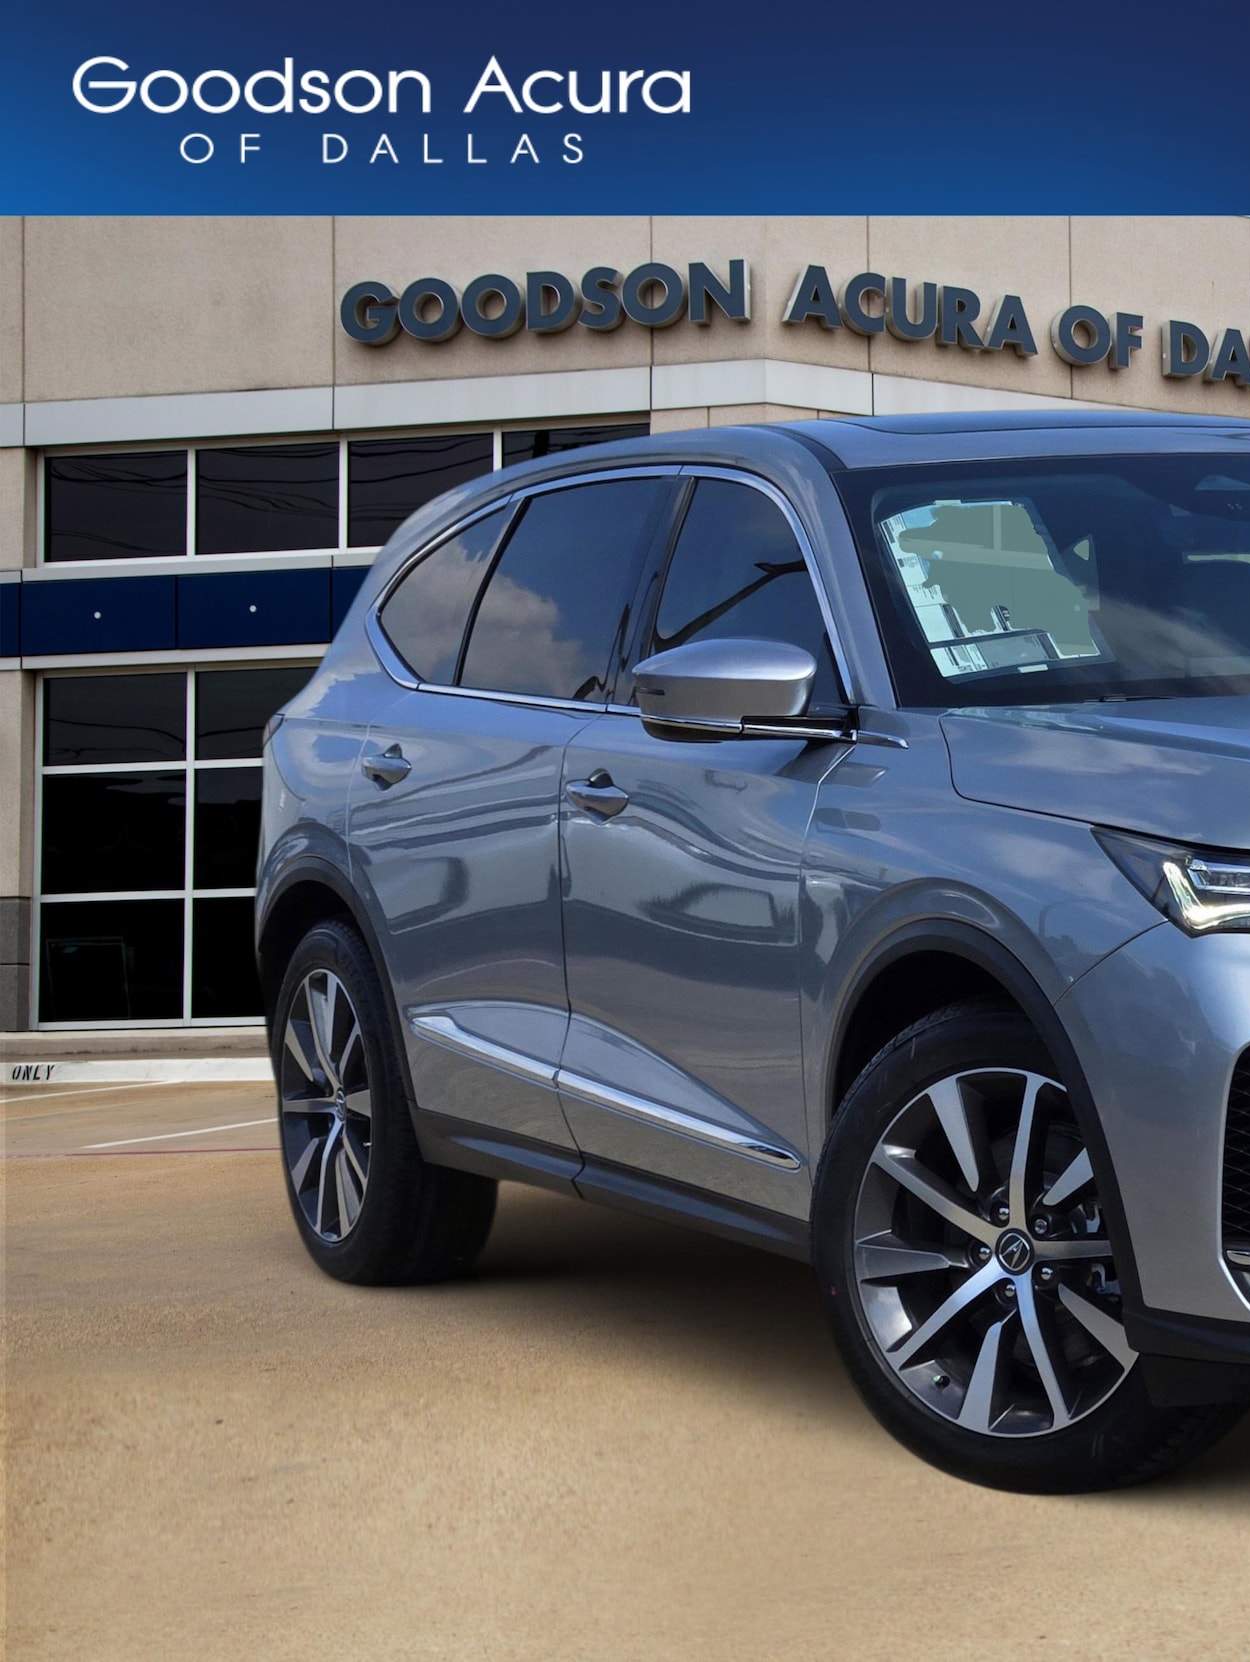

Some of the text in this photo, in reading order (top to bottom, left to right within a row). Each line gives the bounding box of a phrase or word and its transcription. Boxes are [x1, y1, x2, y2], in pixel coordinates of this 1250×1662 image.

[340, 258, 751, 346] GOODSON
[783, 265, 1038, 356] ACURA
[1051, 305, 1143, 369] OF
[11, 1064, 55, 1081] ONLY
